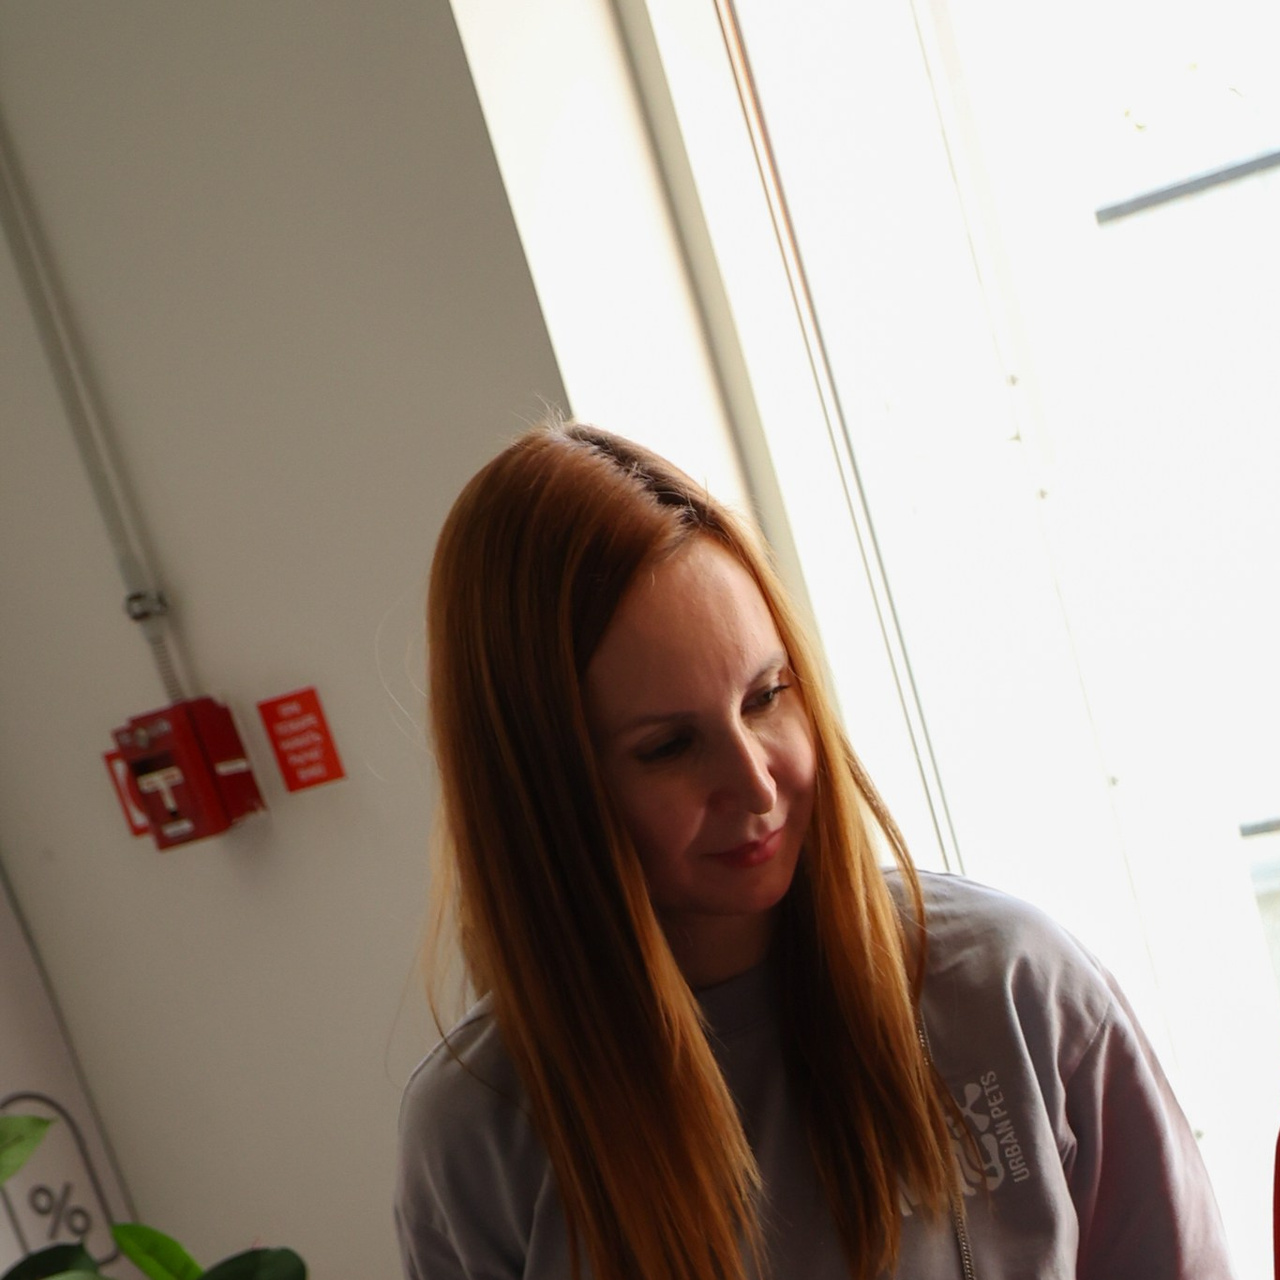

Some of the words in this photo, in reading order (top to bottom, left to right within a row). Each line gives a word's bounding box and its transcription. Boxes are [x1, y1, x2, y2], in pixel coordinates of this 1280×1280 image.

[980, 1070, 1005, 1121] PETS
[996, 1119, 1030, 1183] URBAN
[29, 1181, 92, 1240] %
